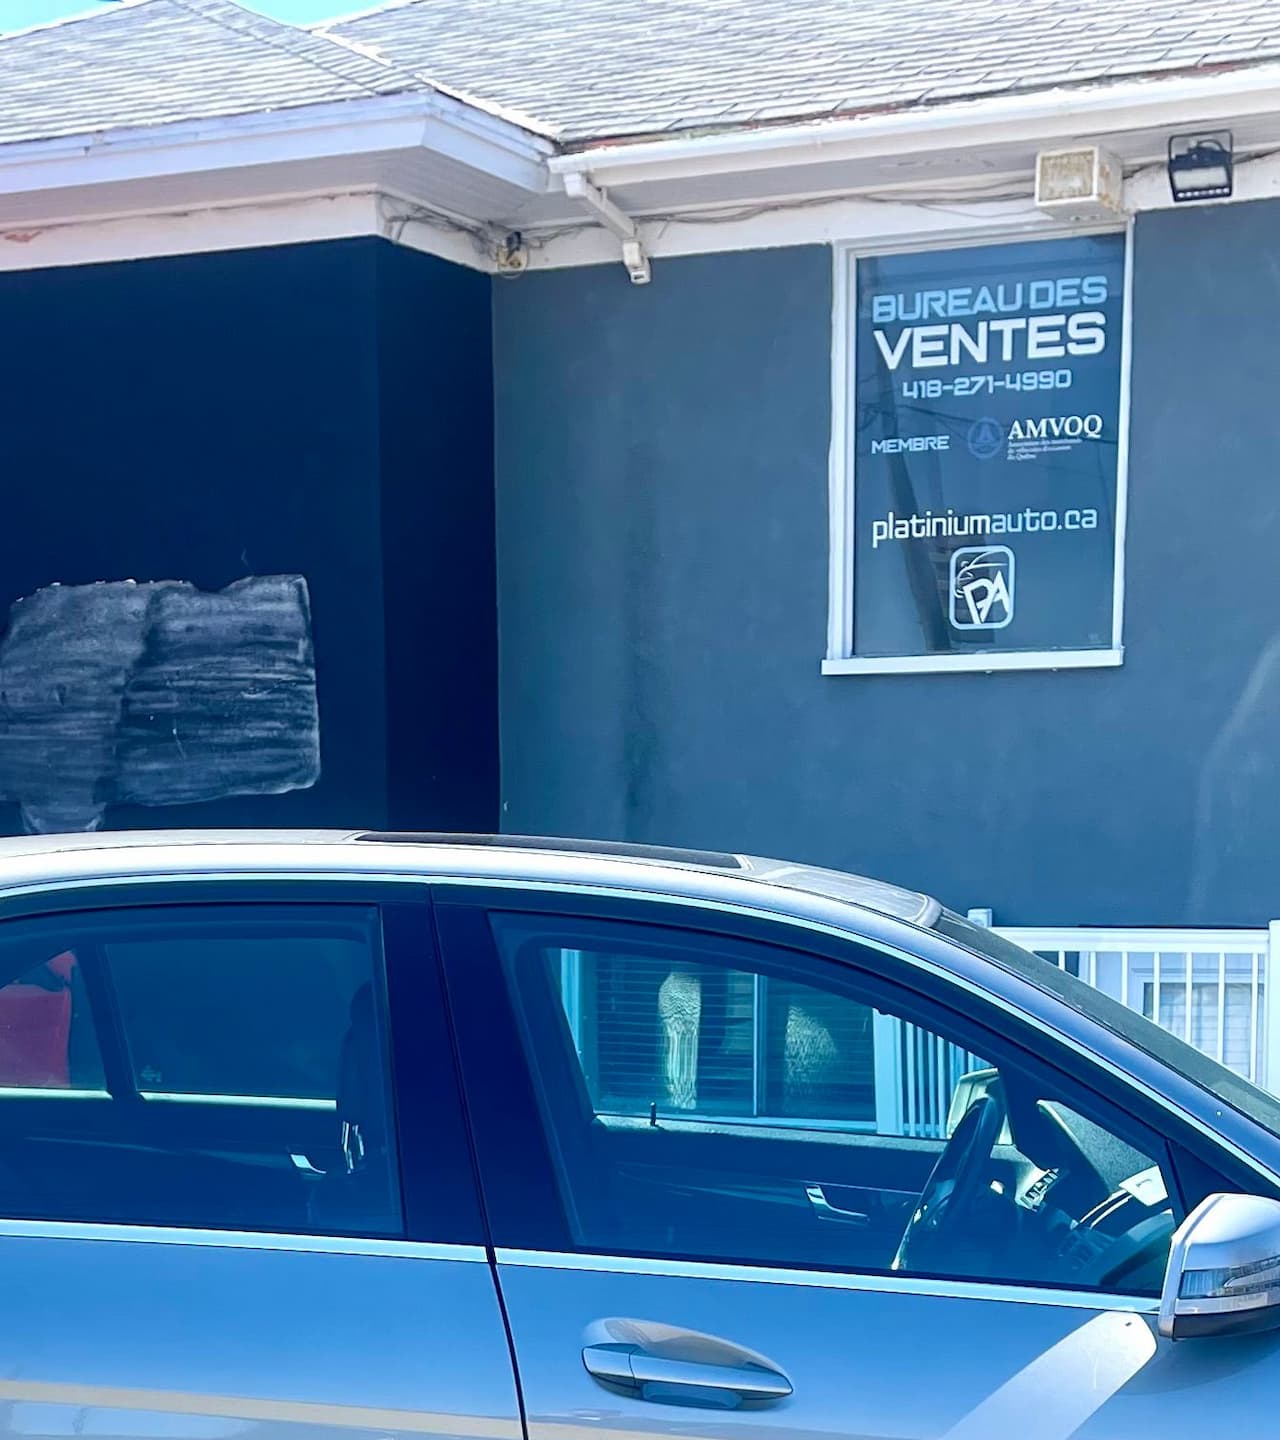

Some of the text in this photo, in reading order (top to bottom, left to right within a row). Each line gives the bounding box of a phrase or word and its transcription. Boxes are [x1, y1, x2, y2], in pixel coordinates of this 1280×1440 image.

[872, 275, 1108, 323] BUREAU DES
[872, 311, 1107, 370] VENTES
[902, 369, 1072, 399] 418-271-4990
[871, 435, 951, 454] MEMBRE
[1007, 414, 1103, 440] AMVOQ
[872, 507, 1098, 548] platiniumauto.ca
